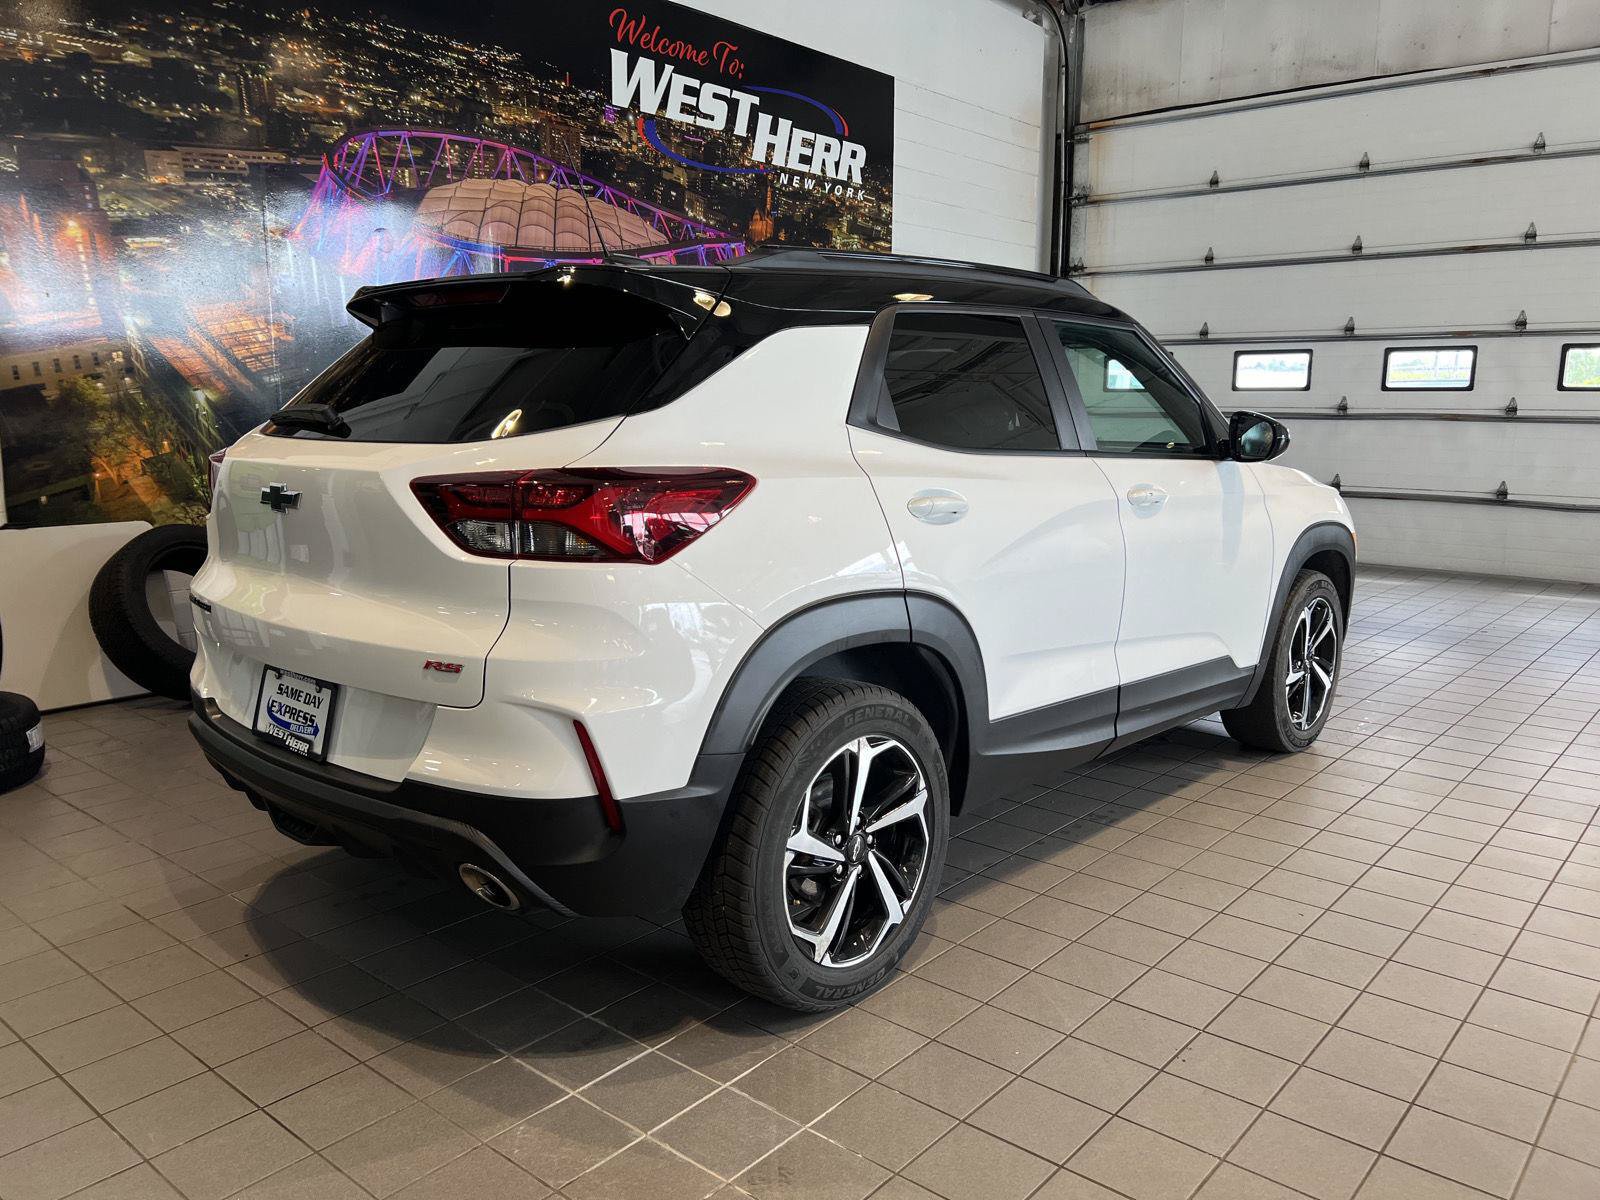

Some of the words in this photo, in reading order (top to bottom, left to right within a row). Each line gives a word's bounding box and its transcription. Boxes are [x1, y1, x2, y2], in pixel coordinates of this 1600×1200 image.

[609, 8, 710, 66] Welcome
[713, 41, 745, 79] To:
[610, 48, 759, 137] WEST
[751, 111, 866, 184] HERR
[780, 172, 815, 190] NEW
[825, 182, 866, 200] YORK
[424, 659, 464, 673] RS
[277, 684, 304, 703] SAME
[305, 692, 324, 709] DAY
[272, 700, 317, 726] EXPRESS
[843, 704, 912, 728] GENERAL
[266, 723, 289, 740] WEST
[286, 735, 309, 753] HERR
[291, 724, 315, 735] DELIVERY
